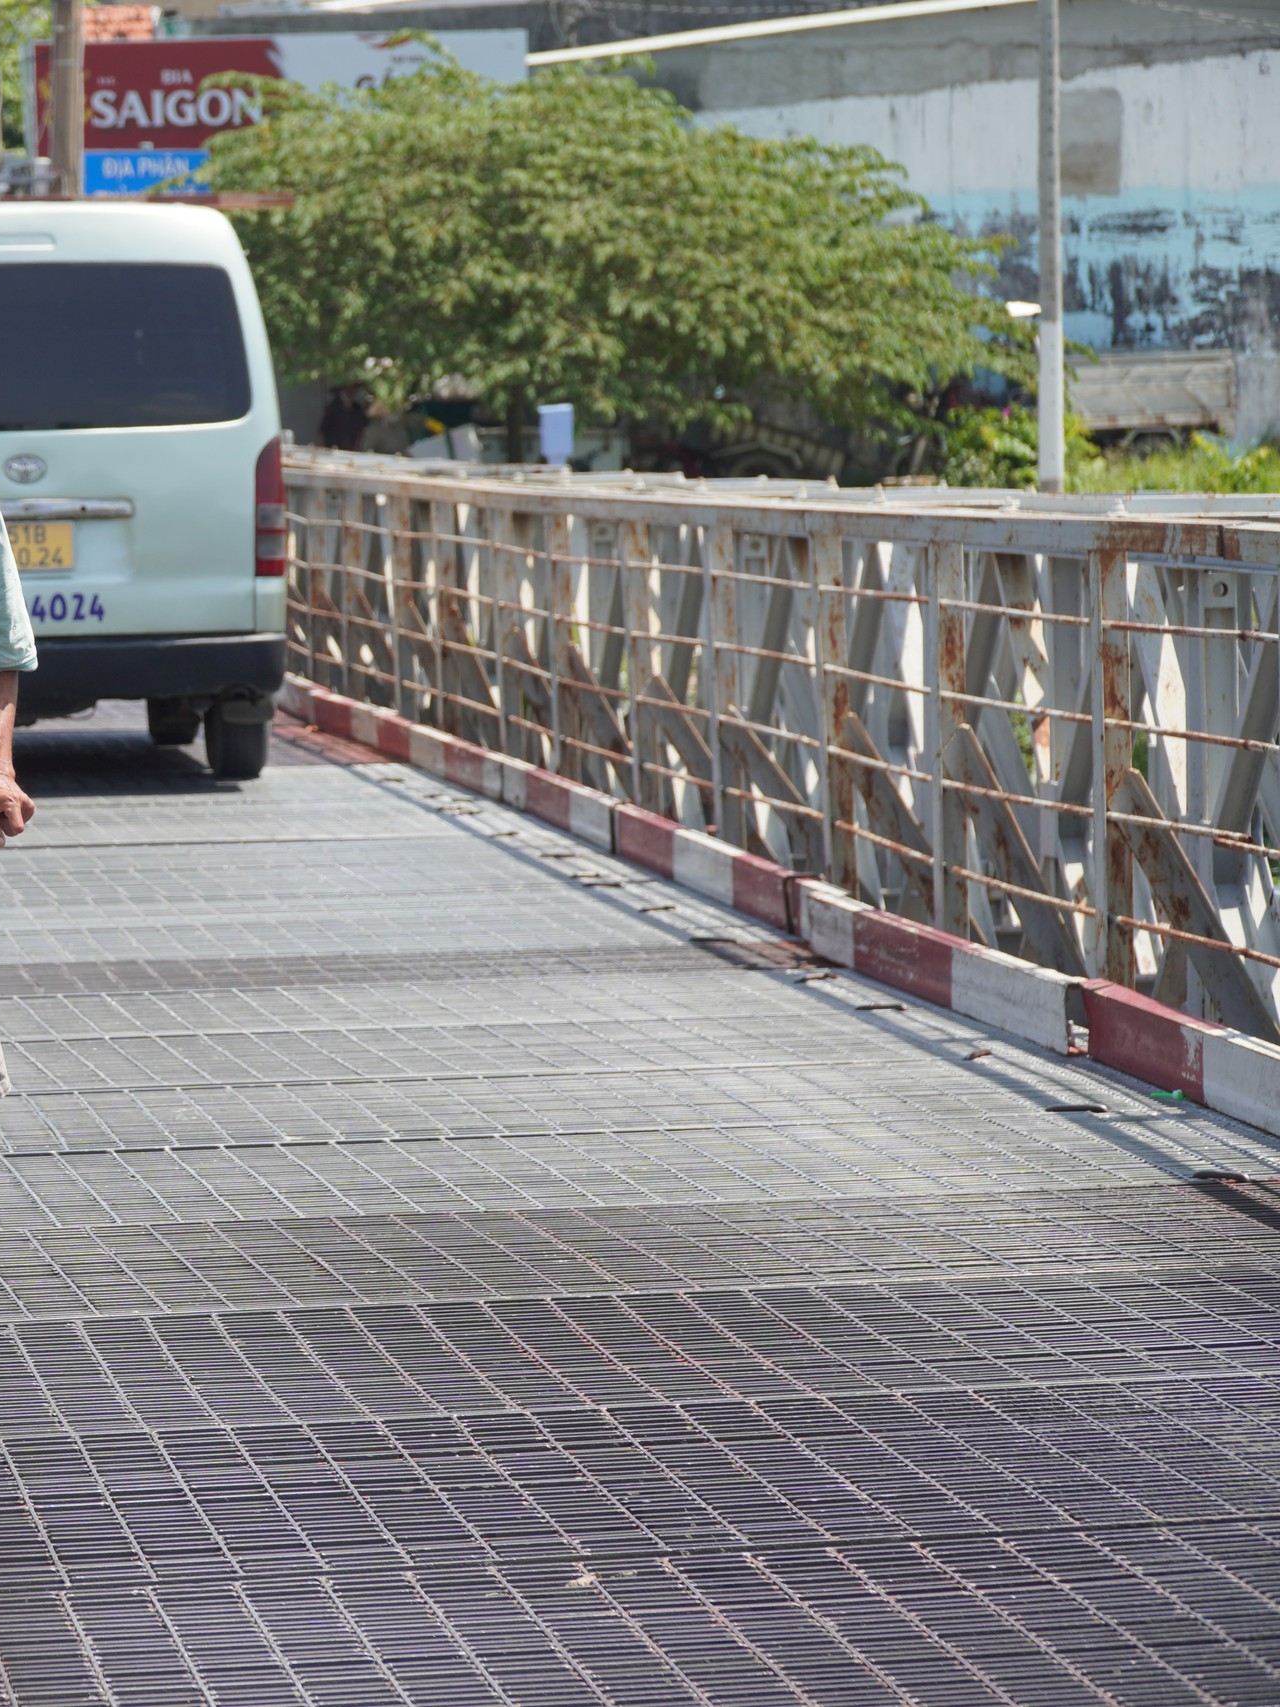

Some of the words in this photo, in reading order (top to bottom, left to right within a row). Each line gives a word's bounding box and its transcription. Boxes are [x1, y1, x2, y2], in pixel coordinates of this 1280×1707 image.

[161, 69, 193, 85] BIA
[90, 88, 263, 128] SAIGON
[7, 524, 47, 544] 51B
[31, 593, 104, 622] 4024
